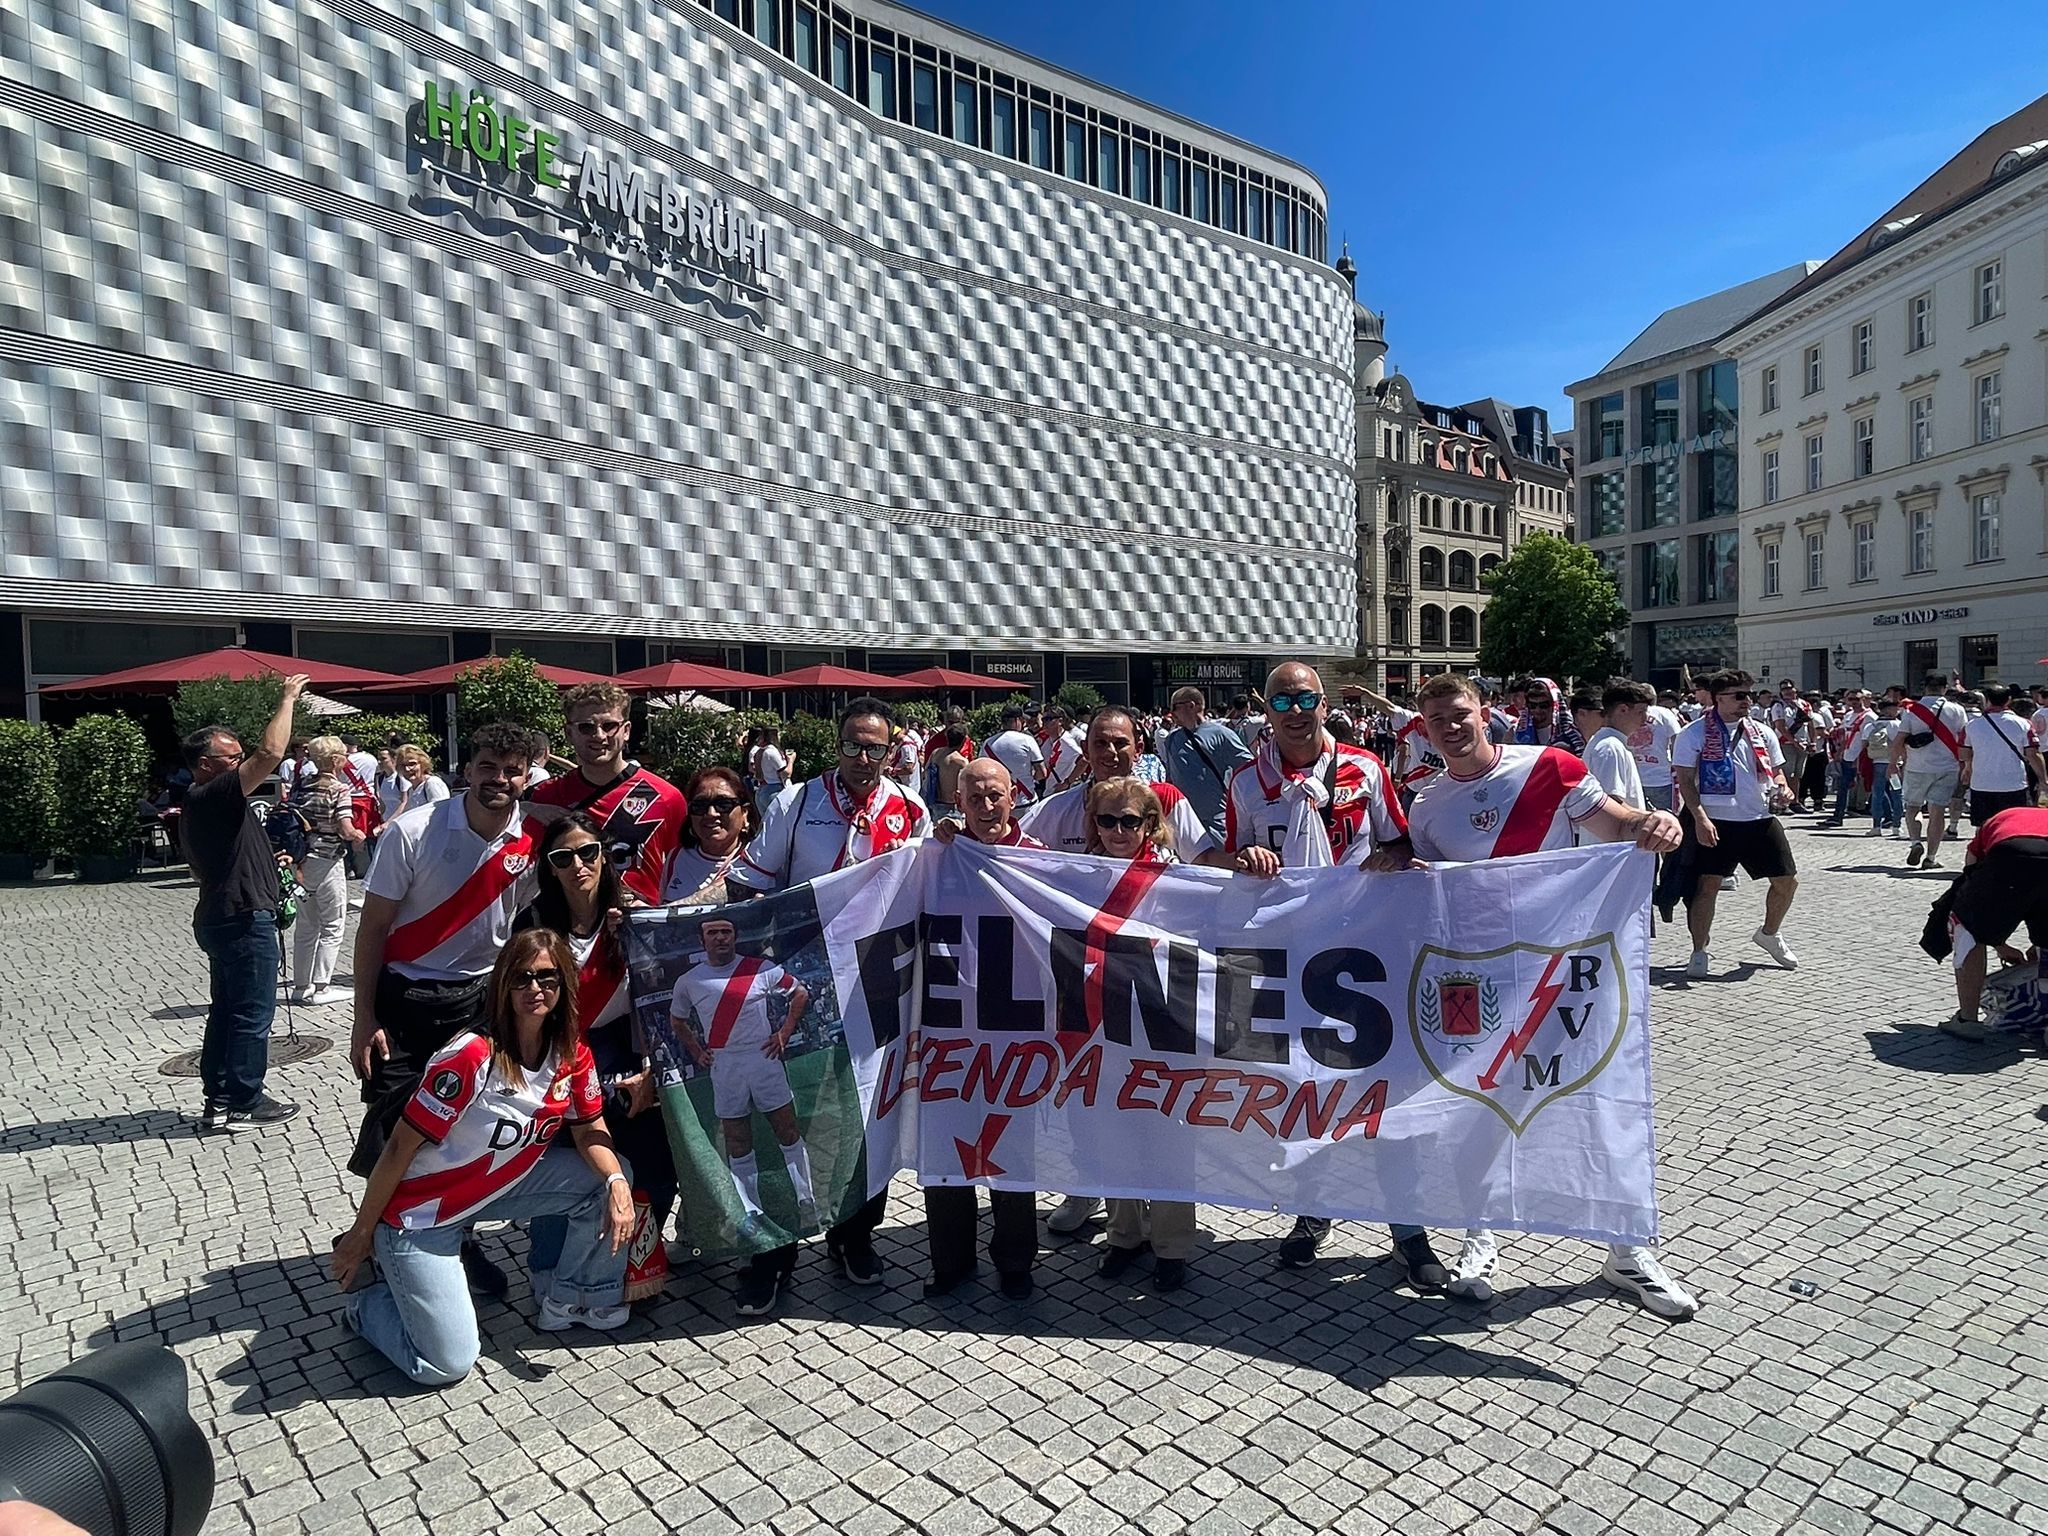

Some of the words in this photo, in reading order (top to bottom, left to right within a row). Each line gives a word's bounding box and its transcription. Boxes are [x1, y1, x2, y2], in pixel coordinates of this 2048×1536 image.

[425, 81, 562, 188] HÖFE
[578, 151, 646, 223] AM
[660, 183, 777, 276] BRÜHL
[1902, 609, 1937, 625] KIND
[987, 663, 1033, 674] BERSHKA
[1197, 664, 1212, 678] AM
[1213, 661, 1242, 678] BRÜHL
[855, 913, 1393, 1070] FELINES
[1568, 955, 1601, 992] R
[1557, 1003, 1594, 1040] V
[1522, 1053, 1563, 1091] M
[1116, 1059, 1388, 1140] ETERNA
